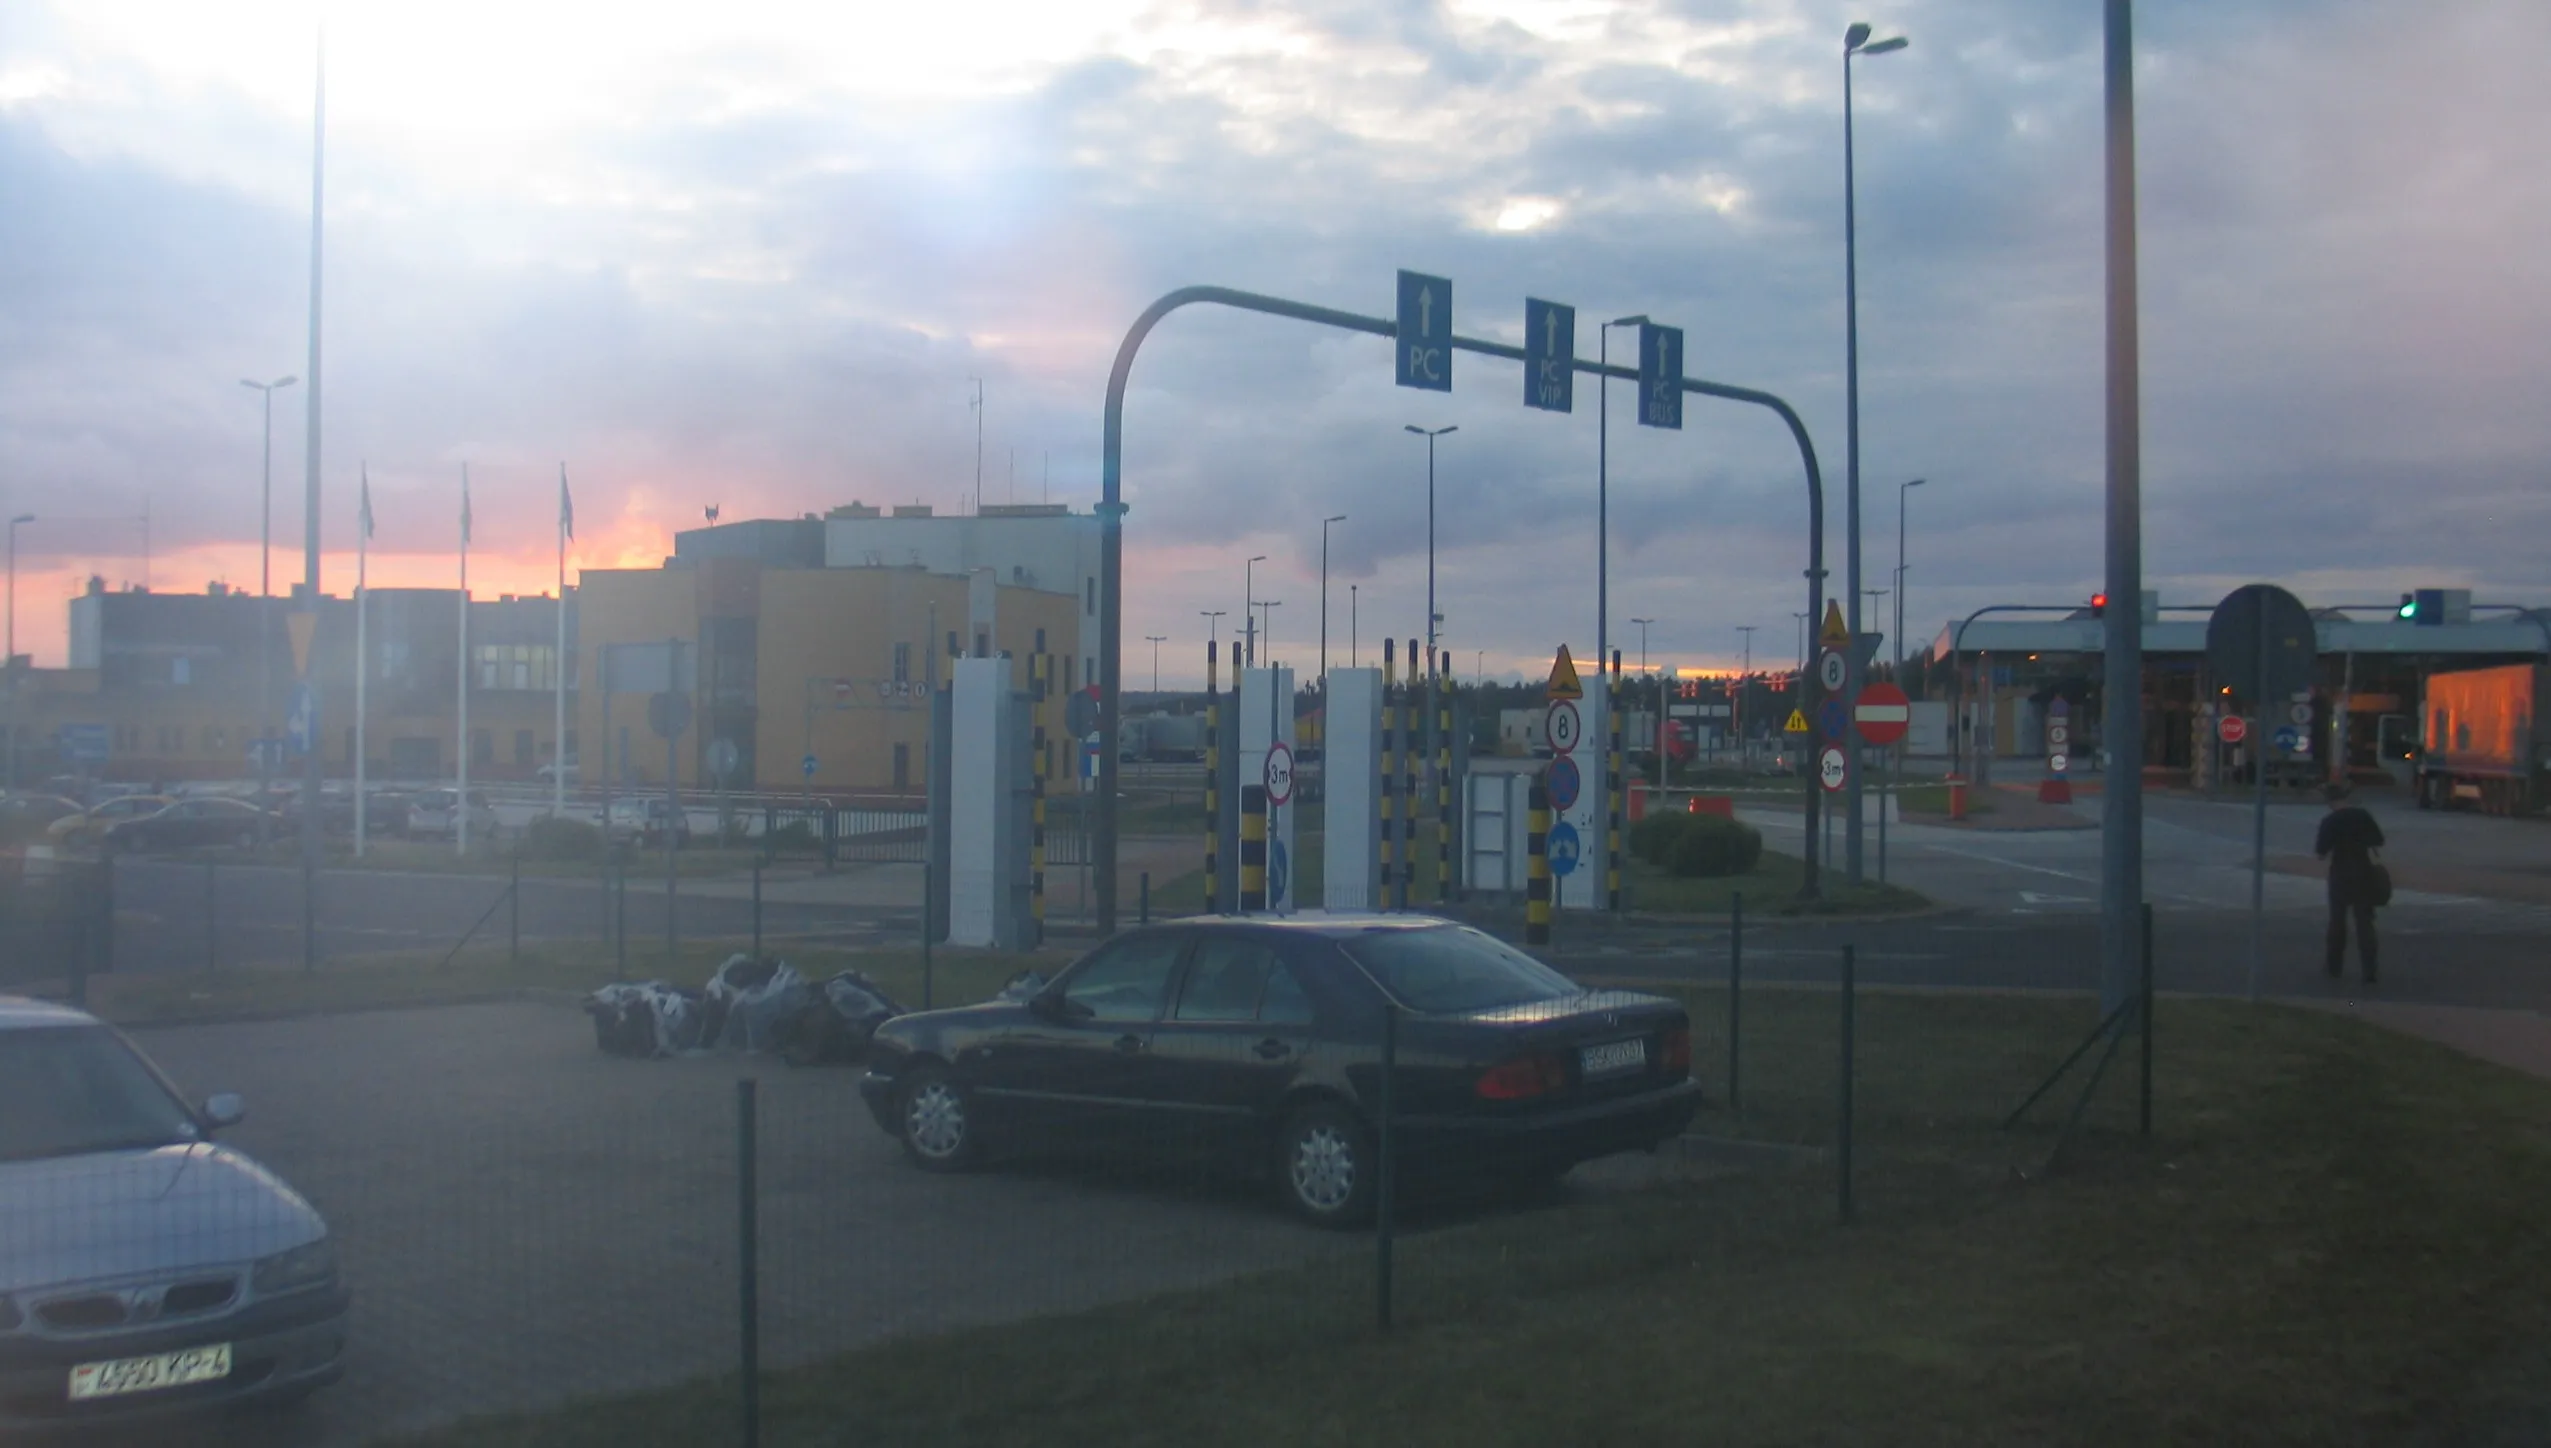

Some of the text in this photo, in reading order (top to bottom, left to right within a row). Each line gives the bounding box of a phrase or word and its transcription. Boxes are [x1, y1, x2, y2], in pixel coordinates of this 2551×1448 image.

[1410, 345, 1440, 381] PC
[1540, 358, 1559, 382] PC
[1538, 385, 1562, 405] VIP
[1652, 380, 1669, 402] PC
[1648, 401, 1675, 424] BUS
[1828, 660, 1838, 682] 8
[1558, 714, 1569, 740] 8
[1271, 764, 1288, 784] 3m
[1823, 760, 1842, 776] 3m
